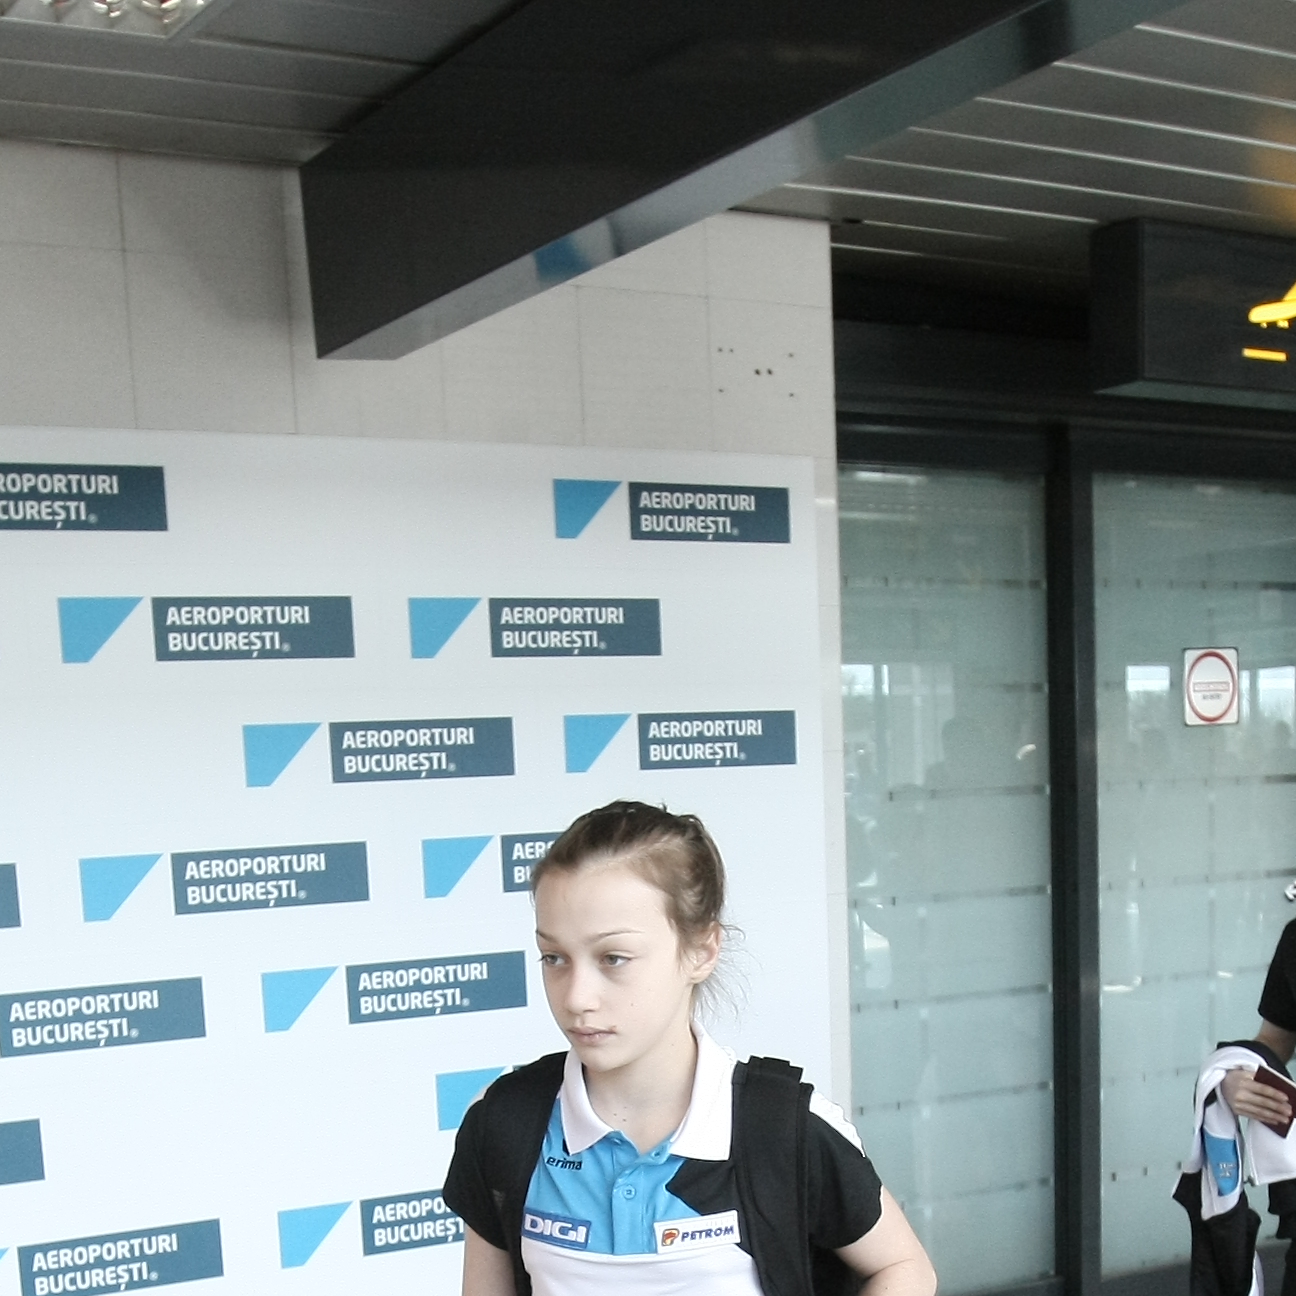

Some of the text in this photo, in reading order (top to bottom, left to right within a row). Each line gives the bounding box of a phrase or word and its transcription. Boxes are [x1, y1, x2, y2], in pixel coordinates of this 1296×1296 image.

[639, 491, 756, 512] AEROPORTURI
[165, 605, 311, 627] AEROPORTURI
[500, 606, 624, 626] AEROPORTURI
[341, 726, 475, 750] AEROPORTURI
[647, 719, 763, 740] AEROPORTURI
[184, 852, 326, 881] AEROPORTURI
[357, 961, 488, 991] AEROPORTURI
[9, 990, 159, 1022] AEROPORTURI
[546, 1155, 583, 1171] erima
[372, 1197, 446, 1223] AEROPO
[373, 1217, 464, 1247] BUCUREȘT
[524, 1214, 587, 1244] DIGI
[680, 1225, 735, 1242] PETROM
[32, 1234, 178, 1271] AEROPORTURI
